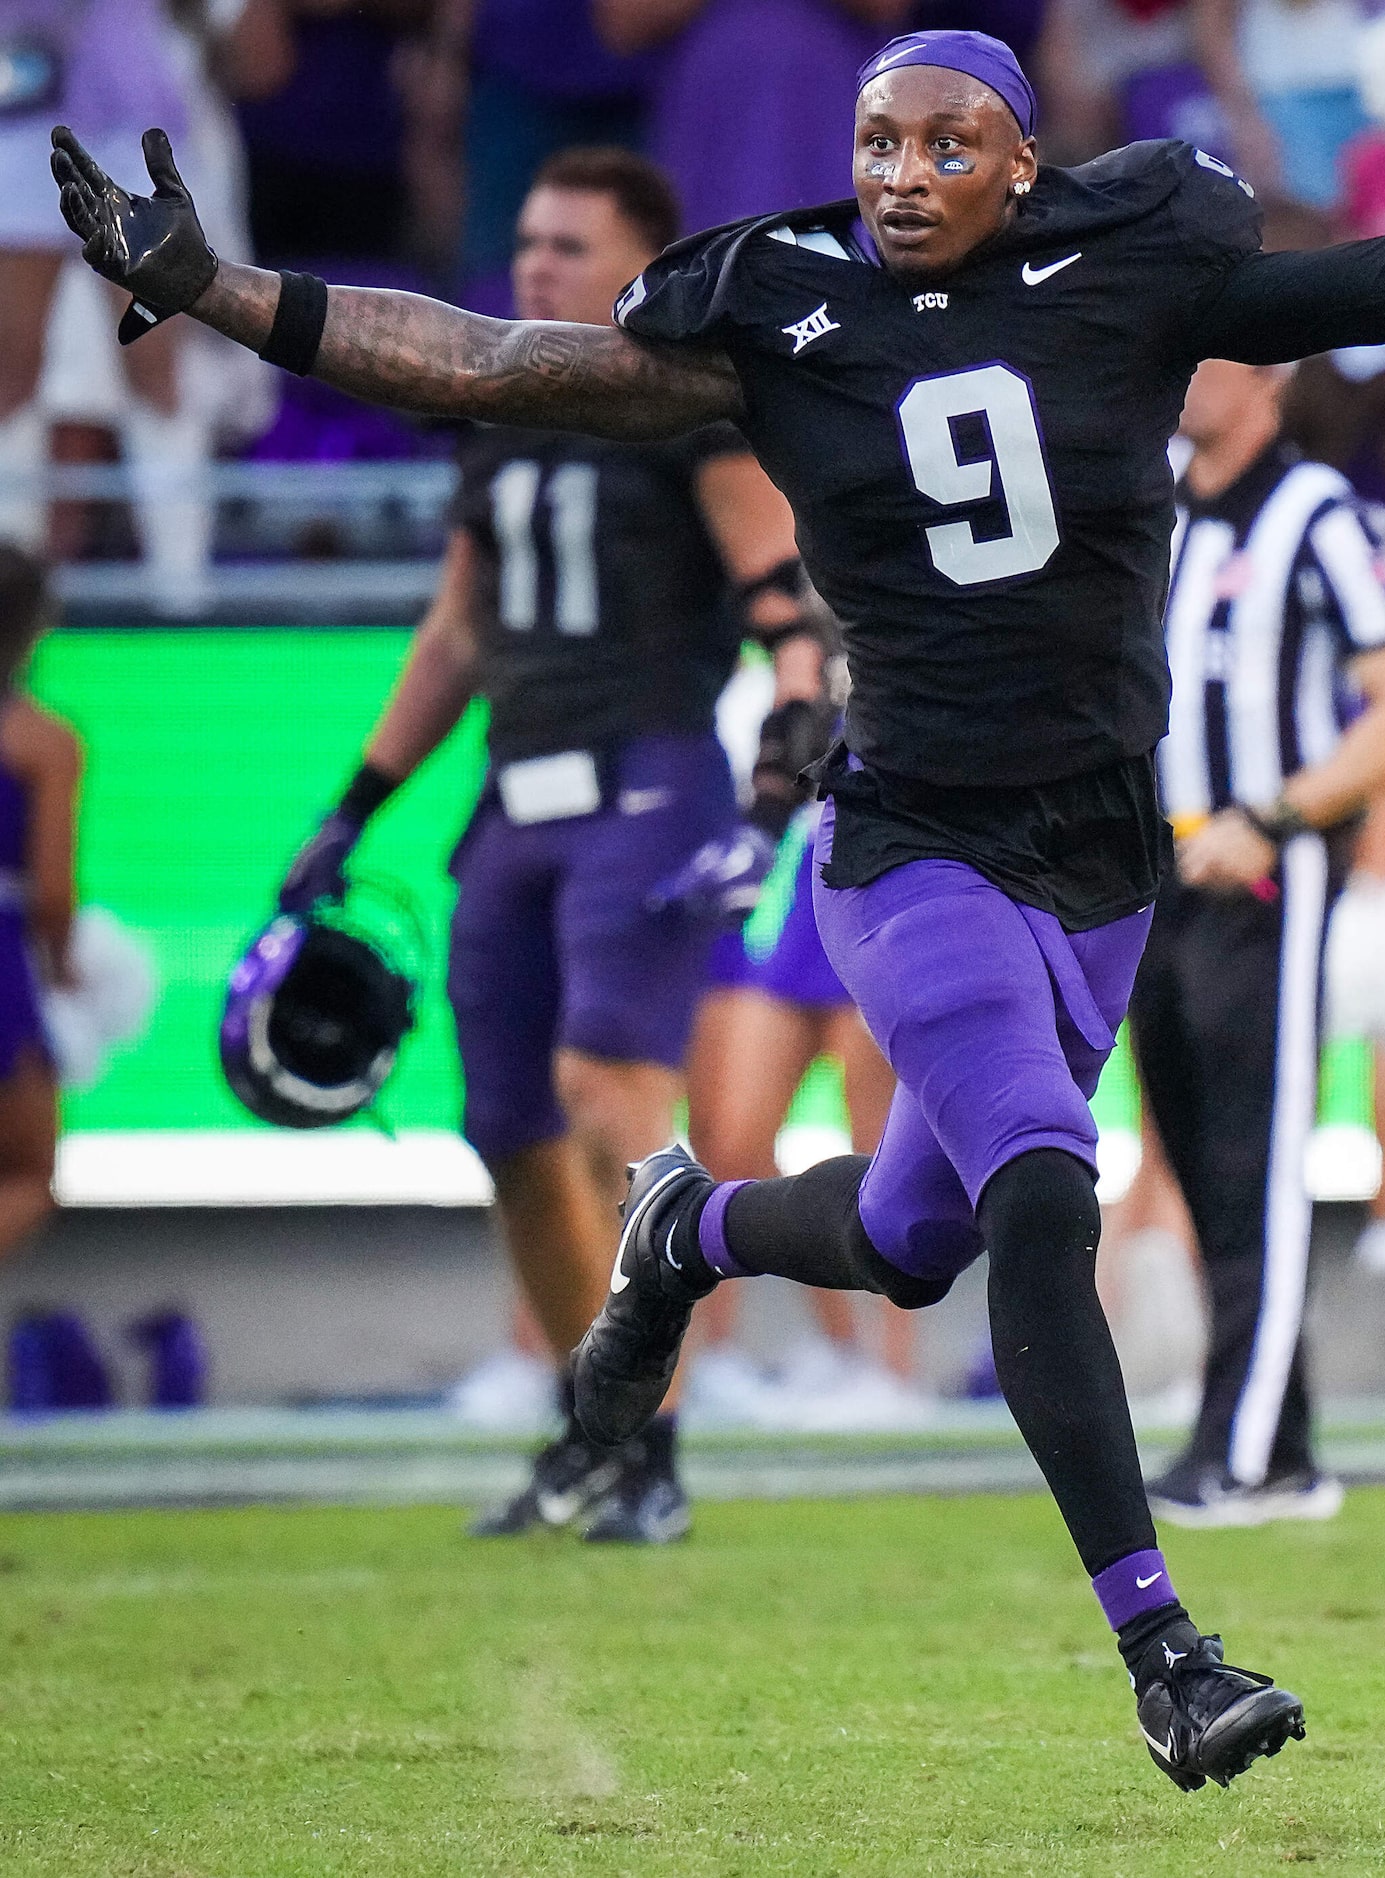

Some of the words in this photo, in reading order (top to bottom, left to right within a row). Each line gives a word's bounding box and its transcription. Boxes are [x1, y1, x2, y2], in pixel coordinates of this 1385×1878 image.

[781, 302, 842, 355] XII
[912, 292, 949, 313] TCU
[897, 361, 1062, 587] 9
[490, 458, 599, 635] 11
